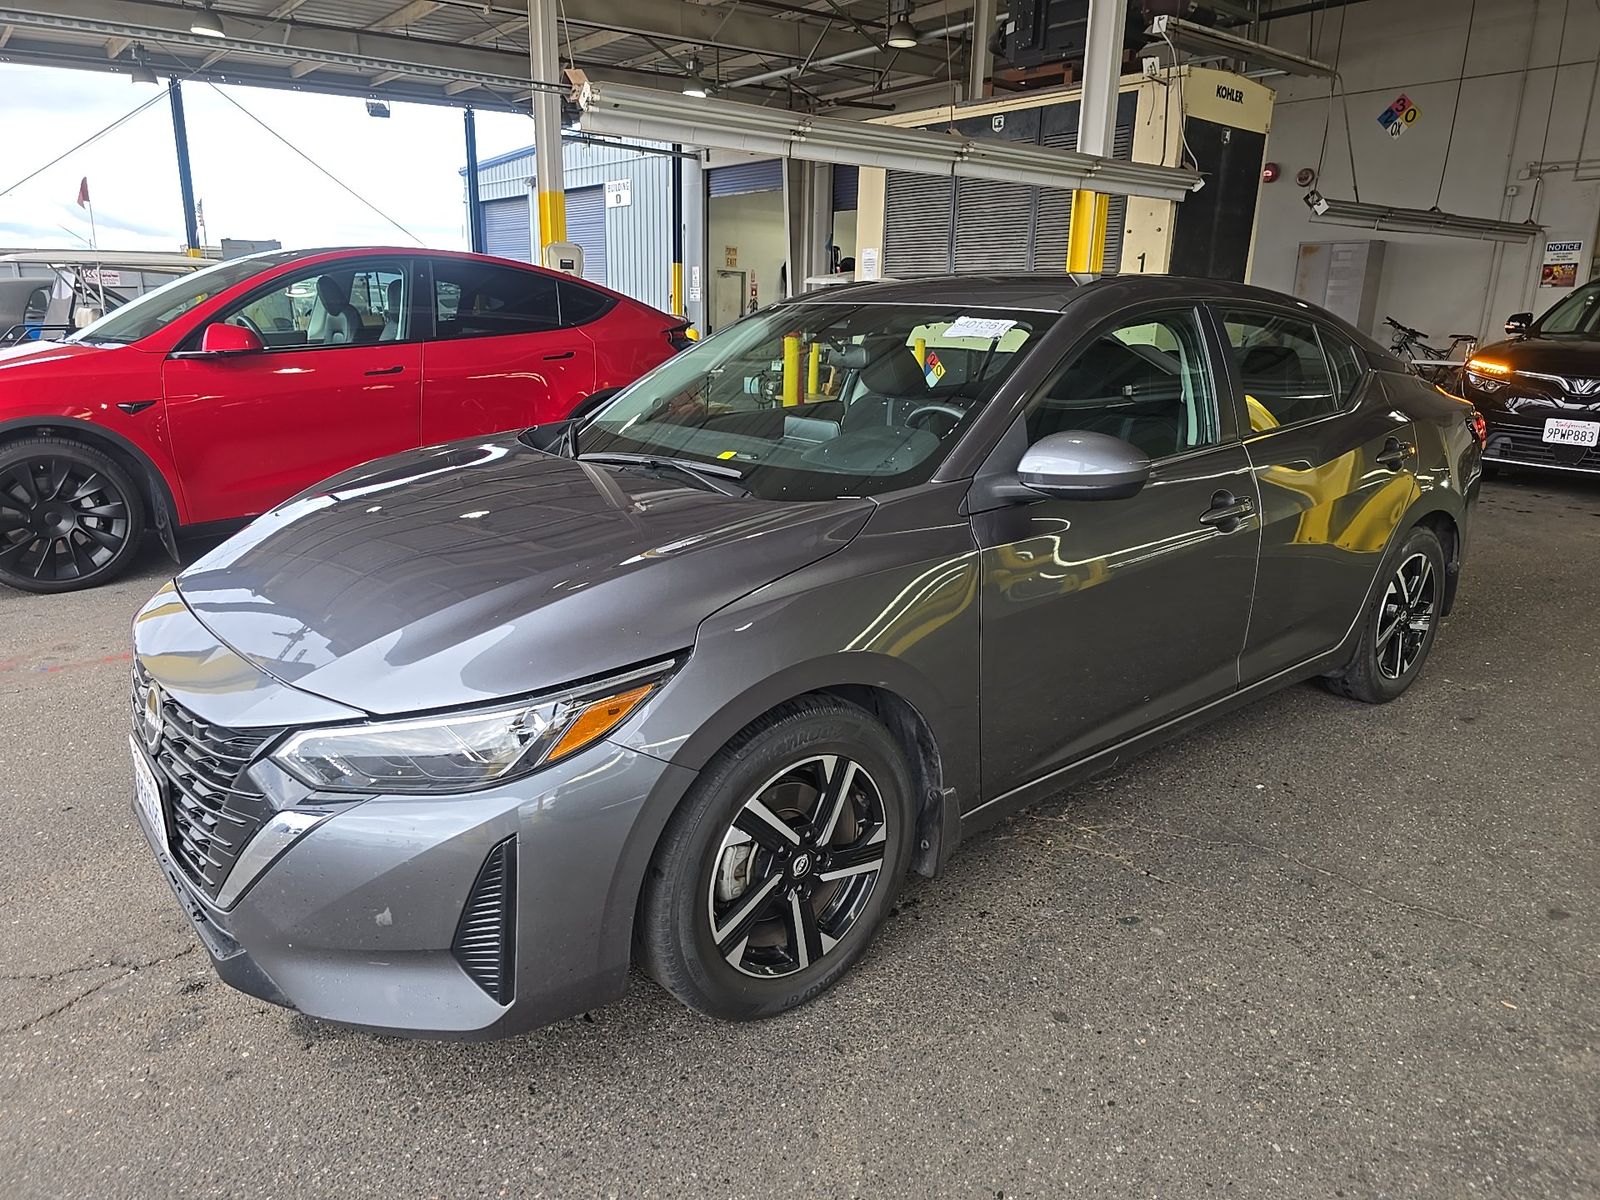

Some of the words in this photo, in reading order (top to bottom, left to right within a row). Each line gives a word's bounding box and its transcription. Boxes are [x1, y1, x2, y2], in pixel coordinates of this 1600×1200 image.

[1216, 84, 1244, 104] KOHLER
[1395, 98, 1406, 112] 3
[1405, 108, 1417, 123] 0
[1391, 121, 1403, 136] OX
[607, 181, 629, 193] BUILDING
[1137, 252, 1145, 272] 1
[930, 353, 936, 365] 2
[1546, 428, 1595, 442] 9PWP883
